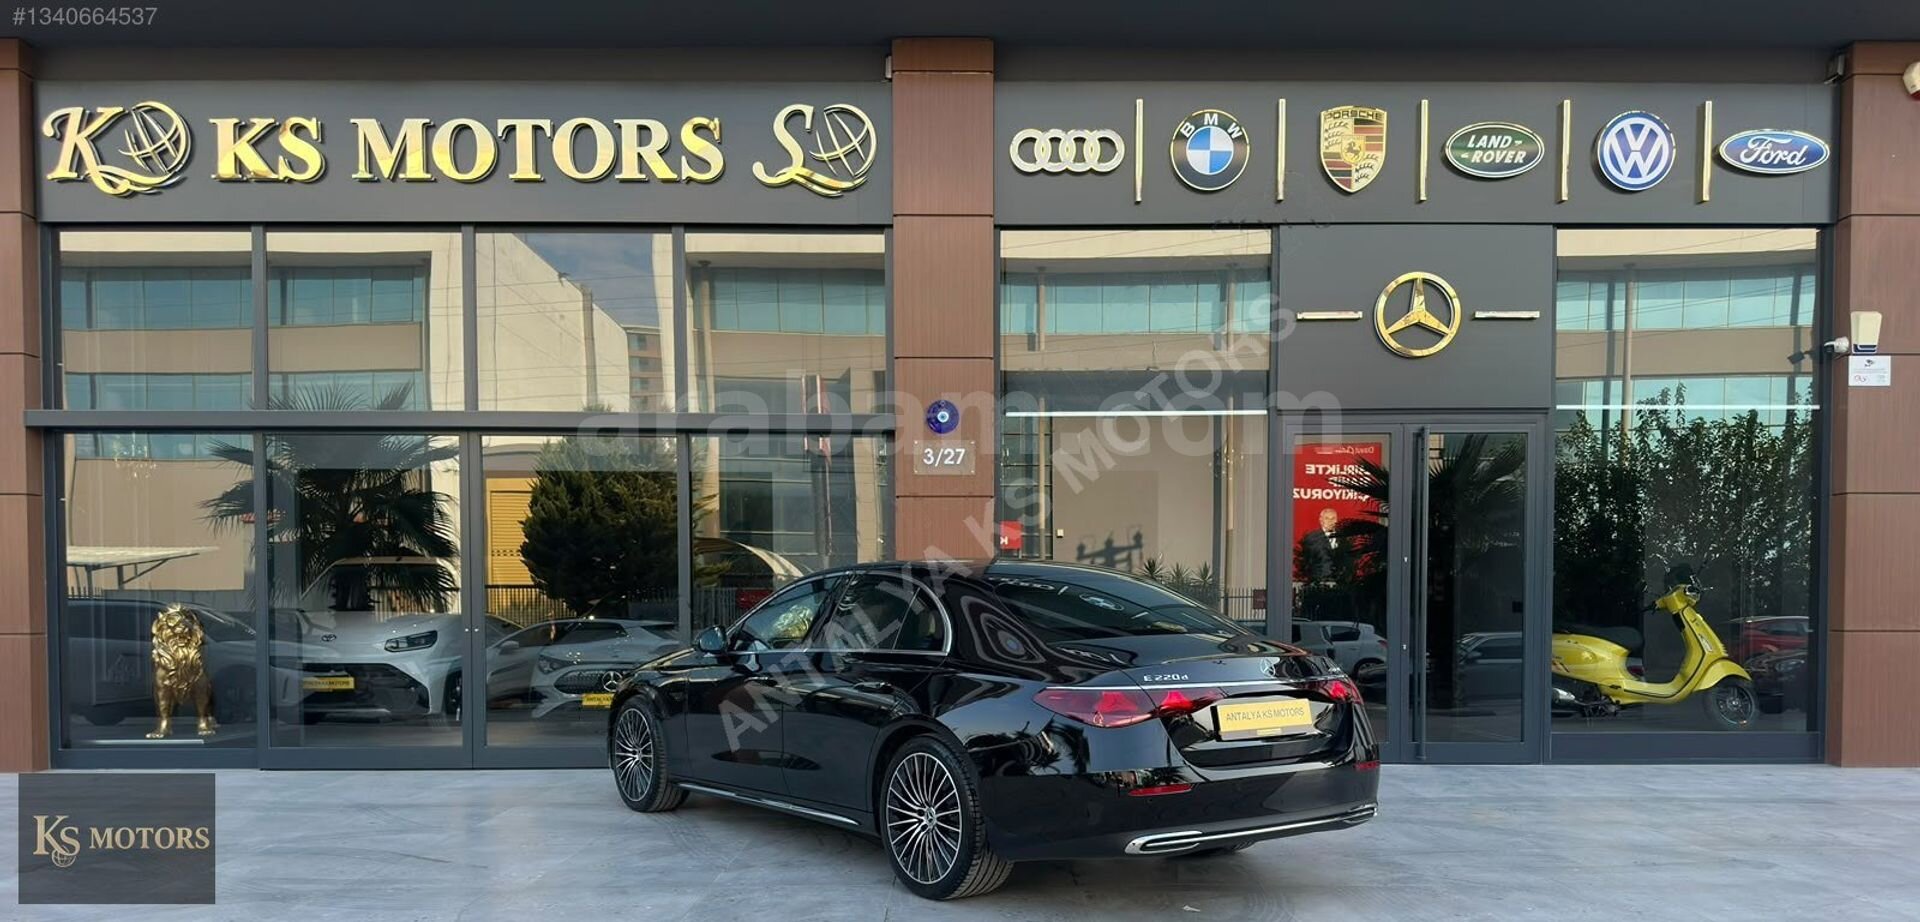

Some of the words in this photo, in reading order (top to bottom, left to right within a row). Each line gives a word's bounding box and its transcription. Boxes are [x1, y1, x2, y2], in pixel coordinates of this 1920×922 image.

[1324, 109, 1384, 121] PORSCHE
[1180, 113, 1243, 138] BMW
[209, 117, 325, 183] KS
[350, 116, 727, 183] MOTORS
[1738, 136, 1807, 166] Ford
[923, 448, 966, 467] 3/27
[1155, 673, 1188, 682] 220d
[1226, 710, 1262, 721] ANTALYA
[1262, 709, 1273, 719] KS
[1273, 707, 1305, 718] MOTORS
